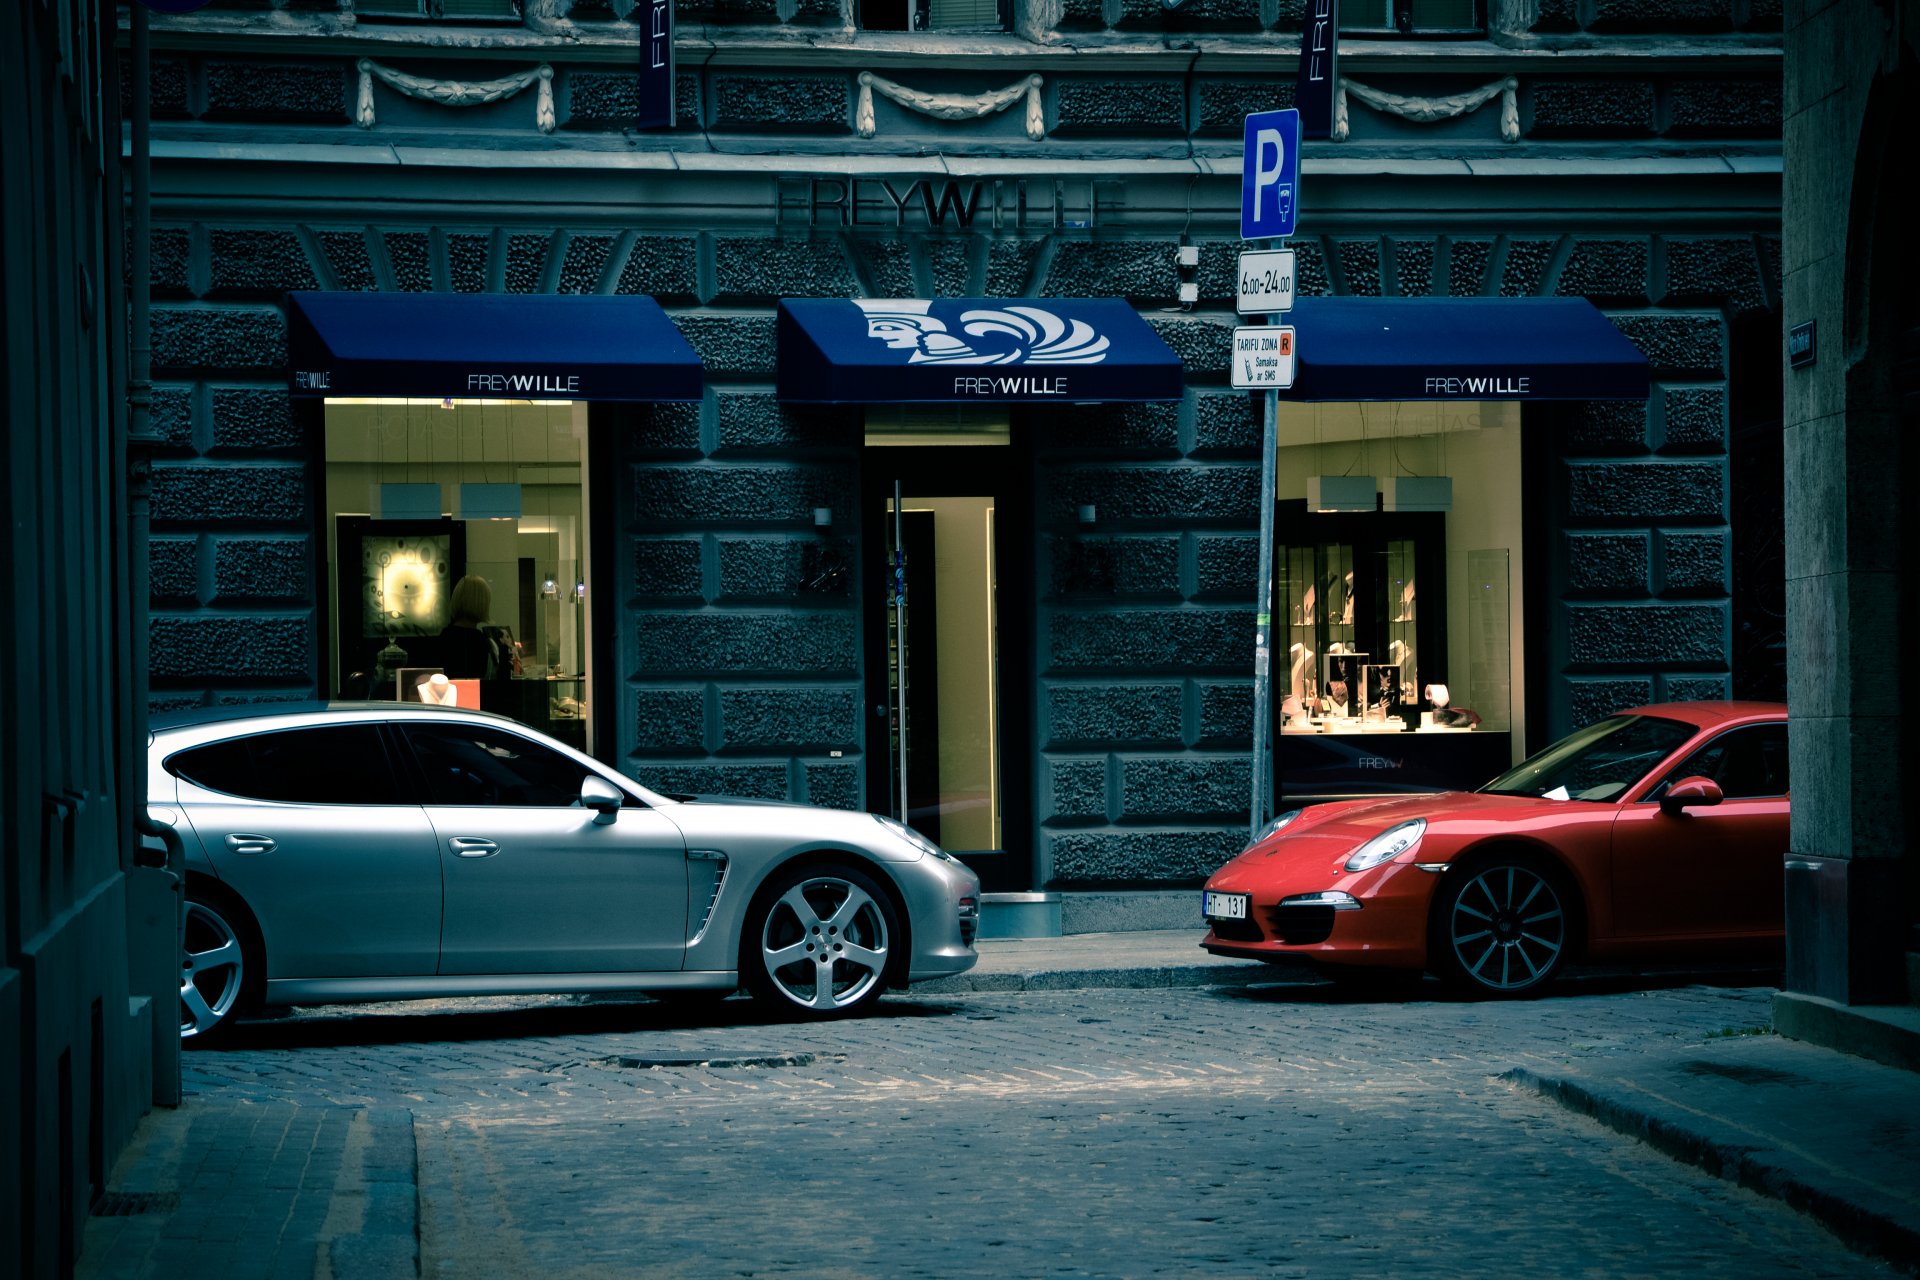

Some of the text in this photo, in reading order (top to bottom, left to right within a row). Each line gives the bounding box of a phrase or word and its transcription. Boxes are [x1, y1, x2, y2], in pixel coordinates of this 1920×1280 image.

[1253, 128, 1285, 223] P
[1241, 269, 1291, 296] 6.00-24.00
[1236, 337, 1289, 352] TARIFU ZONA R
[1255, 356, 1278, 368] Samaksa
[295, 371, 331, 389] FREYWILLE
[467, 374, 580, 392] FREYWILLE
[1256, 370, 1276, 381] ar SMS
[954, 377, 1068, 394] FREYWILLE
[1425, 377, 1530, 393] FREYWILLE
